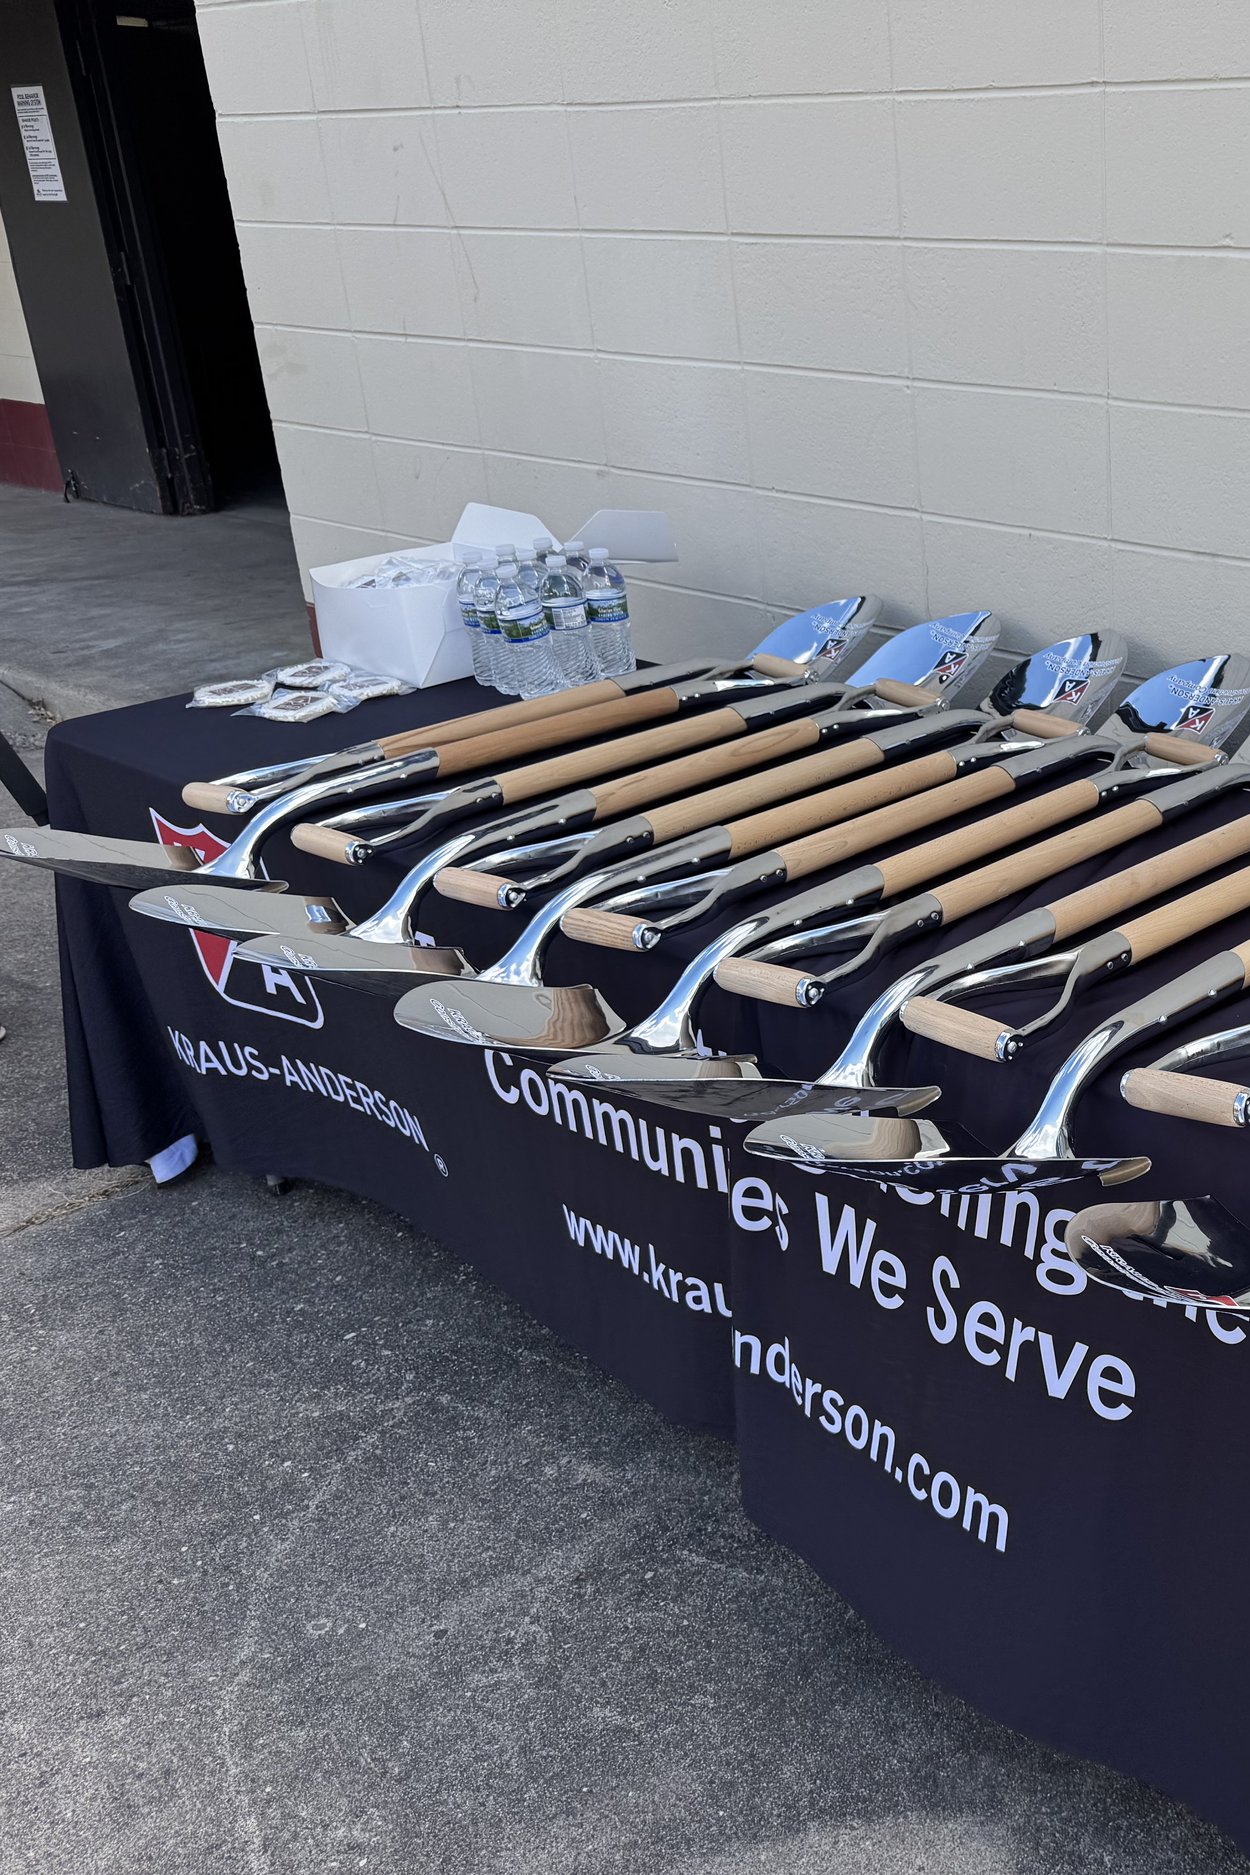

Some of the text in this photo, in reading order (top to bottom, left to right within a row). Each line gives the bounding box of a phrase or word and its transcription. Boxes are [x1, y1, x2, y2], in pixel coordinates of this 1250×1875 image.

[1065, 681, 1076, 692] A
[1067, 691, 1082, 702] K
[1188, 707, 1200, 719] A
[1190, 718, 1205, 731] K
[167, 1025, 430, 1151] KRAUS-ANDERSON
[484, 1048, 789, 1251] Communies
[815, 1192, 907, 1310] We
[926, 1256, 1137, 1421] Serve
